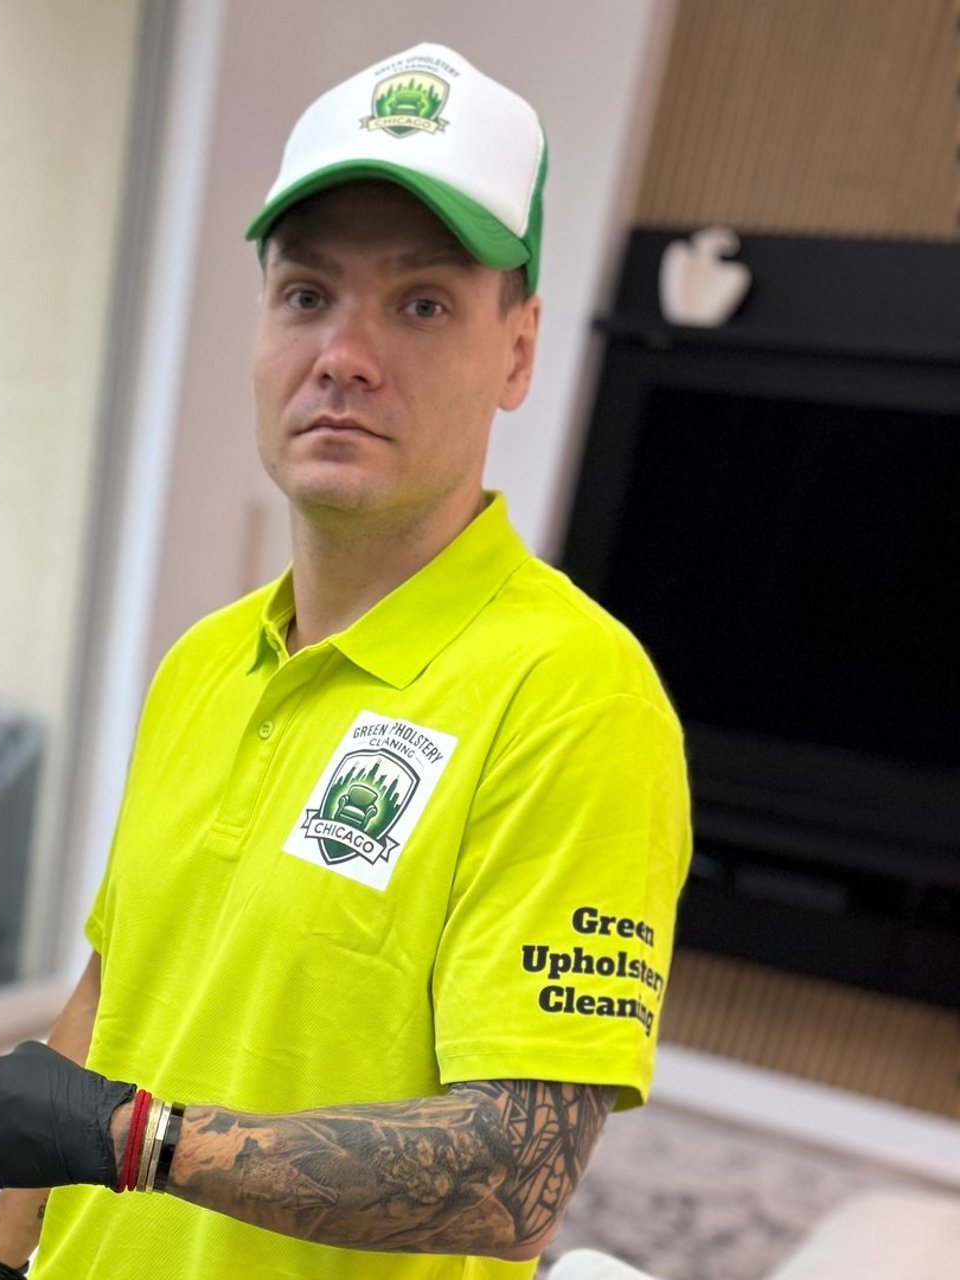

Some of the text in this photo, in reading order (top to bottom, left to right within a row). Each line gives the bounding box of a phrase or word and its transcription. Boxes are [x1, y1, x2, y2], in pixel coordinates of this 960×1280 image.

[374, 118, 432, 129] CHICAGO
[353, 723, 388, 739] GREEN
[313, 821, 375, 854] CHICAGO
[572, 906, 655, 948] Green
[538, 984, 654, 1038] Cleaning
